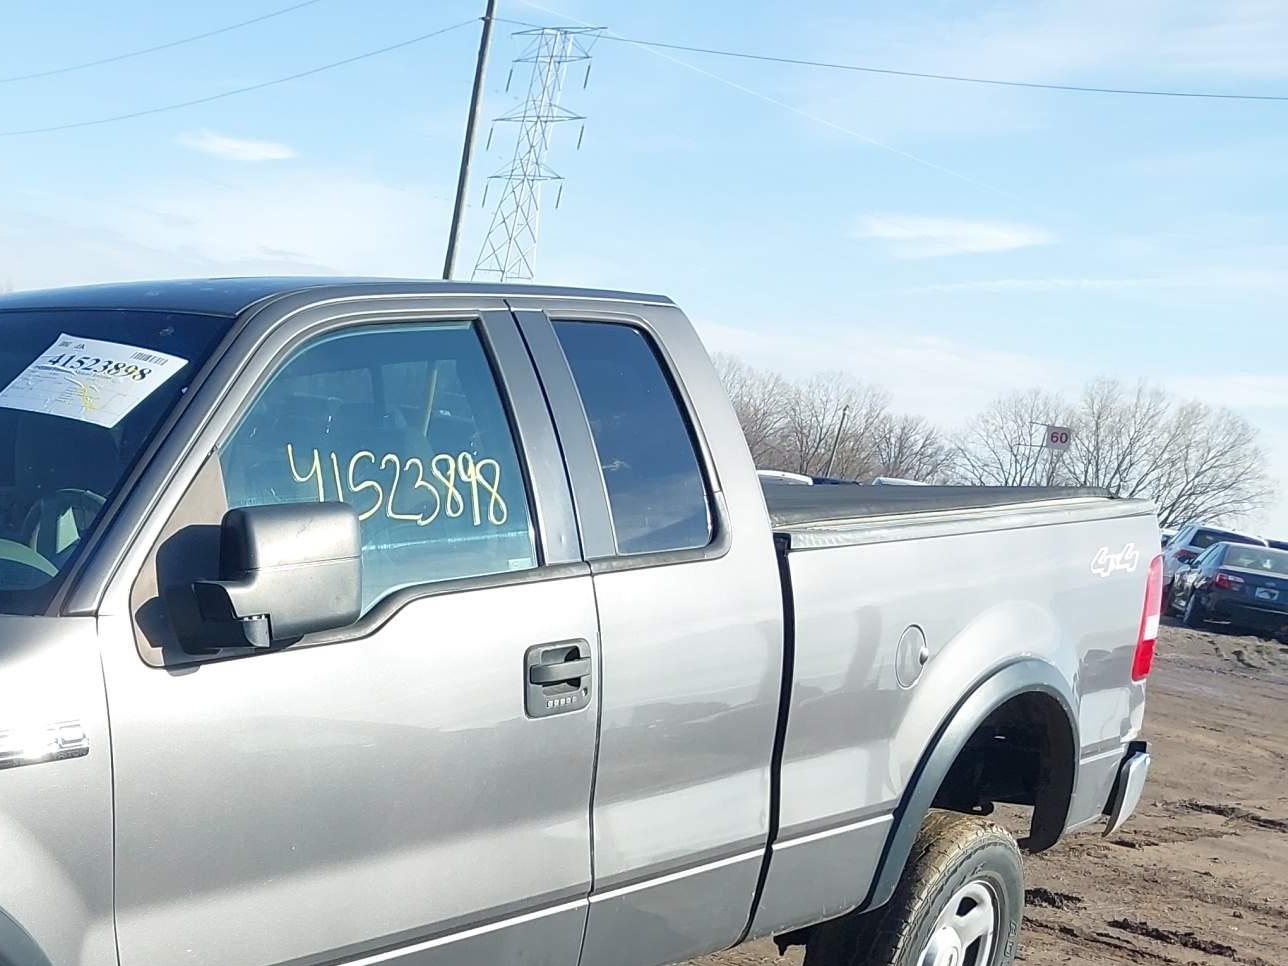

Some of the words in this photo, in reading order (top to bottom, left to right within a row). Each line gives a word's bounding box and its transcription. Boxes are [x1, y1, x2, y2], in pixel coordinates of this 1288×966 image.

[48, 353, 152, 381] 41523898
[1050, 431, 1069, 444] 60
[286, 443, 508, 526] 41523898
